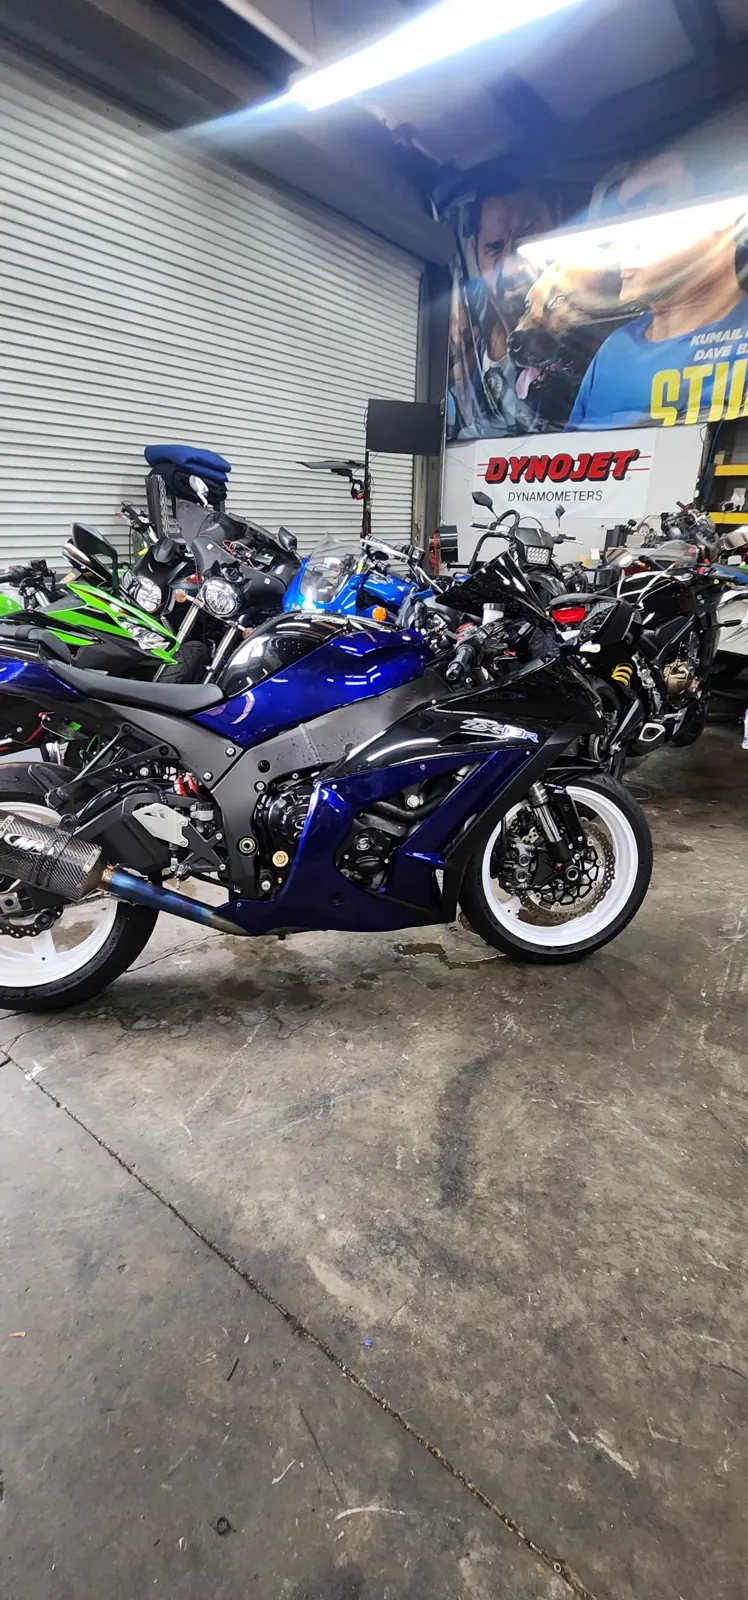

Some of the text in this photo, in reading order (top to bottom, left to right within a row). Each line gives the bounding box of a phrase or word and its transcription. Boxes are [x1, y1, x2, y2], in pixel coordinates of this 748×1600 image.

[690, 328, 742, 347] KUMAIL
[693, 345, 733, 361] DAVE
[485, 449, 640, 484] DYNOJET
[507, 490, 604, 502] DYNAMOMETERS
